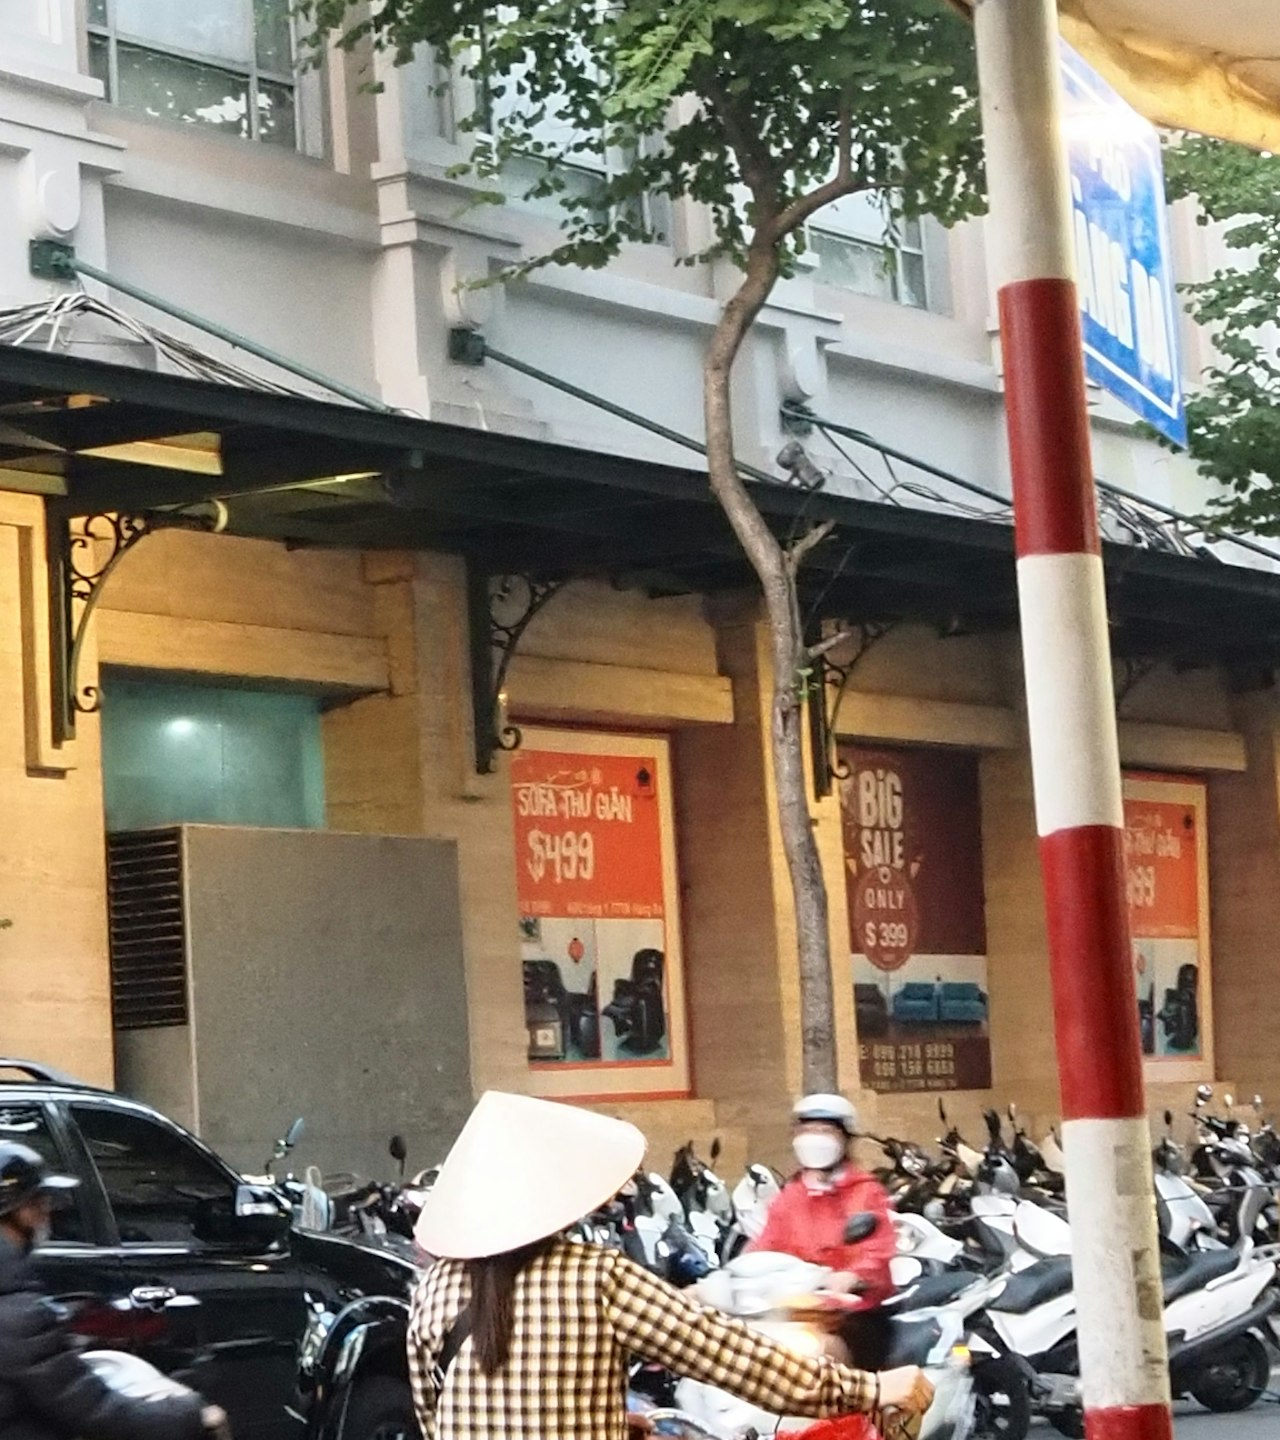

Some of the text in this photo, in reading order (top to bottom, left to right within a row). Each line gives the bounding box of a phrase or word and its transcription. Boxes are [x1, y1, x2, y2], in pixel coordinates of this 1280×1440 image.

[860, 828, 905, 870] SALE
[865, 887, 905, 910] ONLY
[878, 923, 908, 948] 399
